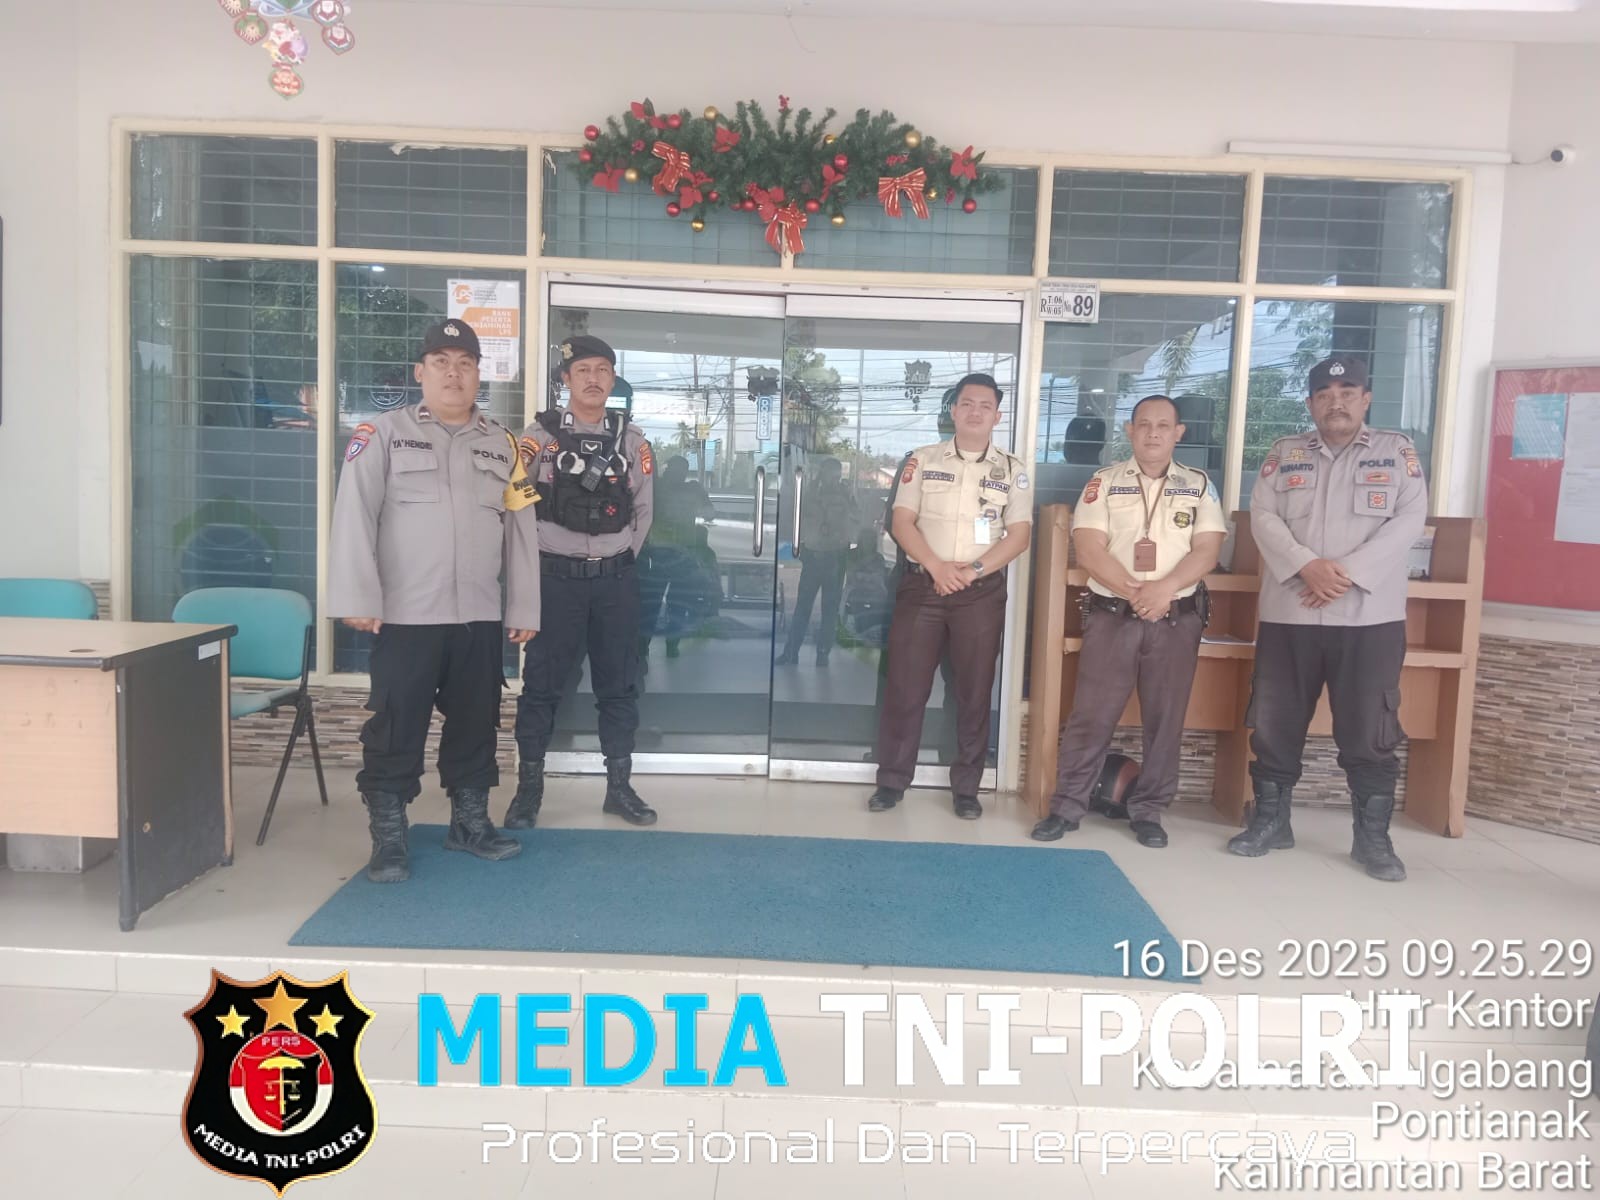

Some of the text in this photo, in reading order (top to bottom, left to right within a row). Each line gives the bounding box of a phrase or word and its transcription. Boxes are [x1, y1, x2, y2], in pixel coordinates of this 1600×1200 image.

[1072, 294, 1094, 317] 89
[472, 450, 508, 464] POLRI
[1359, 459, 1396, 469] POLRI
